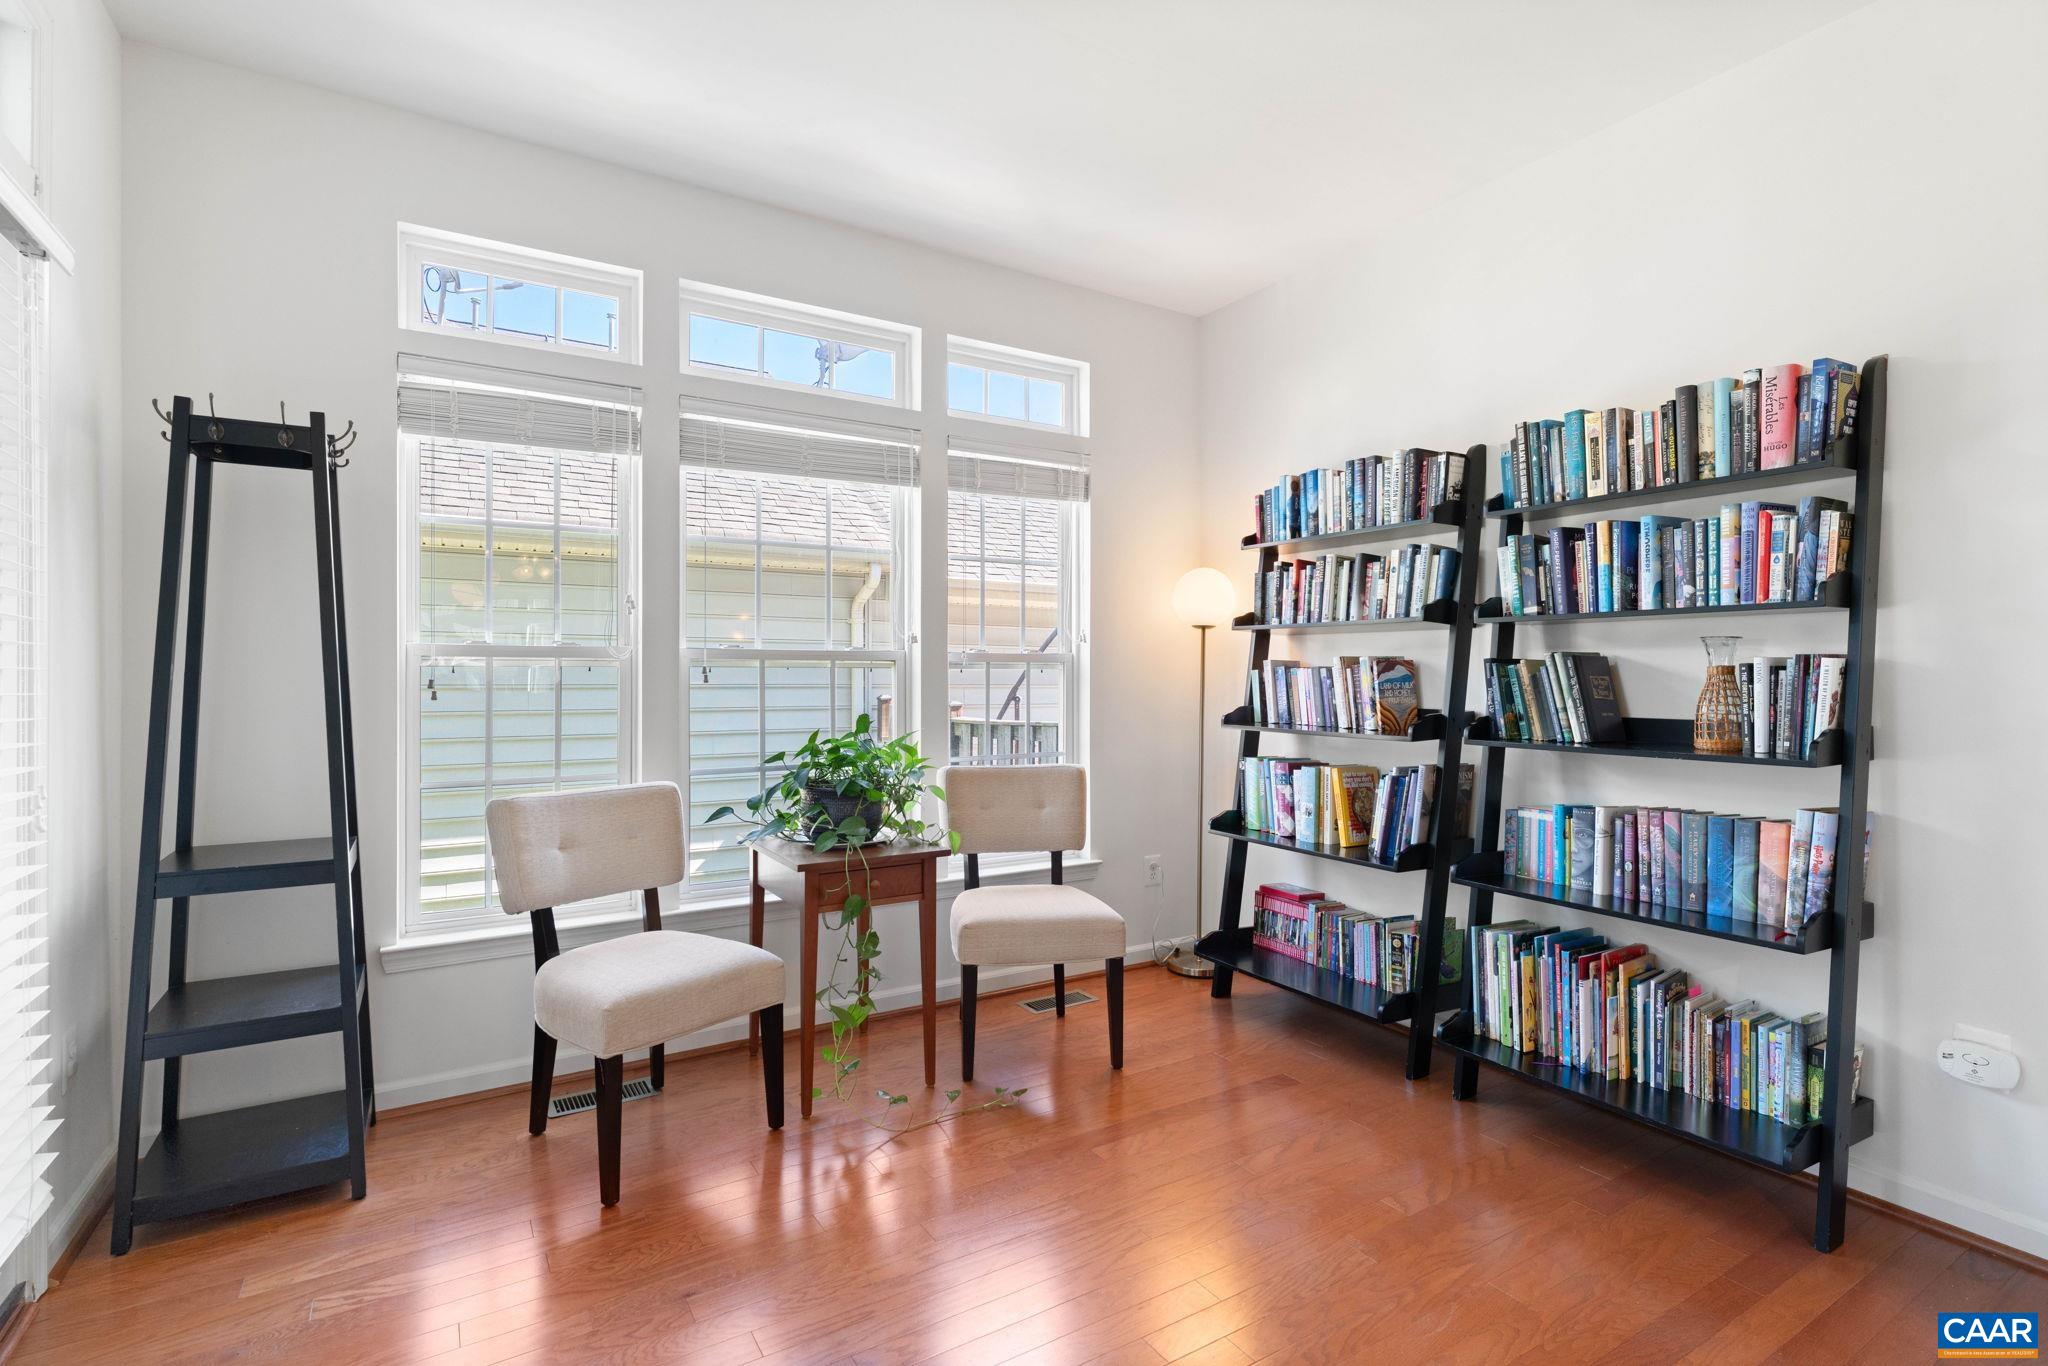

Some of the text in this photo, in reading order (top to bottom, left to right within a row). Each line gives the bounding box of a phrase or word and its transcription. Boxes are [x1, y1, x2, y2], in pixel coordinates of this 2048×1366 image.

[1764, 376, 1779, 435] Misérables
[1778, 396, 1788, 410] Les
[1763, 443, 1788, 452] HUGO
[1643, 522, 1651, 573] ATMOSPHERE
[1554, 551, 1562, 577] PERFECT
